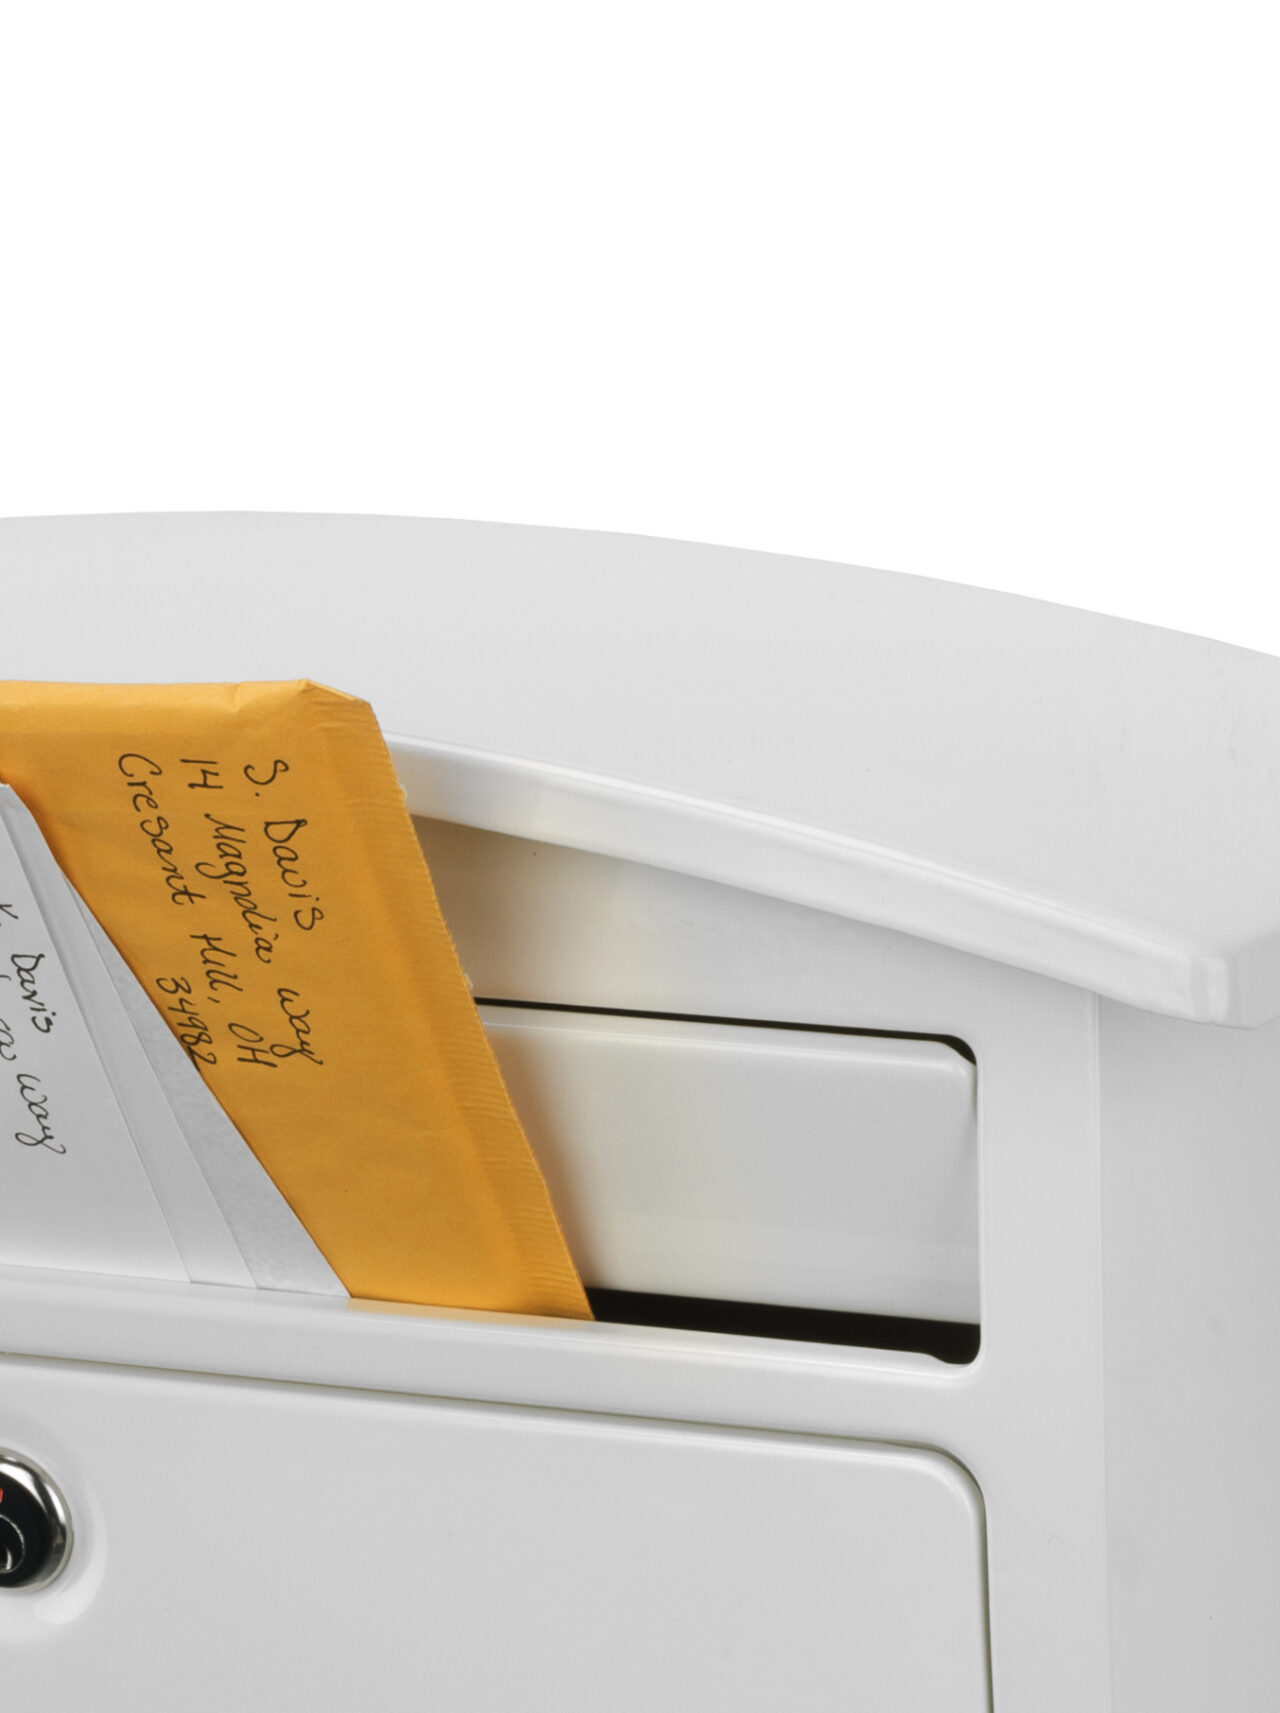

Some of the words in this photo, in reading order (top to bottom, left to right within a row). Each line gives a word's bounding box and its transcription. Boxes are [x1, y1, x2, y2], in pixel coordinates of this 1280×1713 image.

[180, 758, 224, 790] 14
[244, 759, 289, 797] S.
[118, 753, 206, 905] Cresant
[228, 1022, 278, 1068] OH
[195, 813, 279, 964] Magnolia
[264, 819, 324, 930] Davis
[11, 953, 54, 1034] Davis
[156, 977, 217, 1073] 34982
